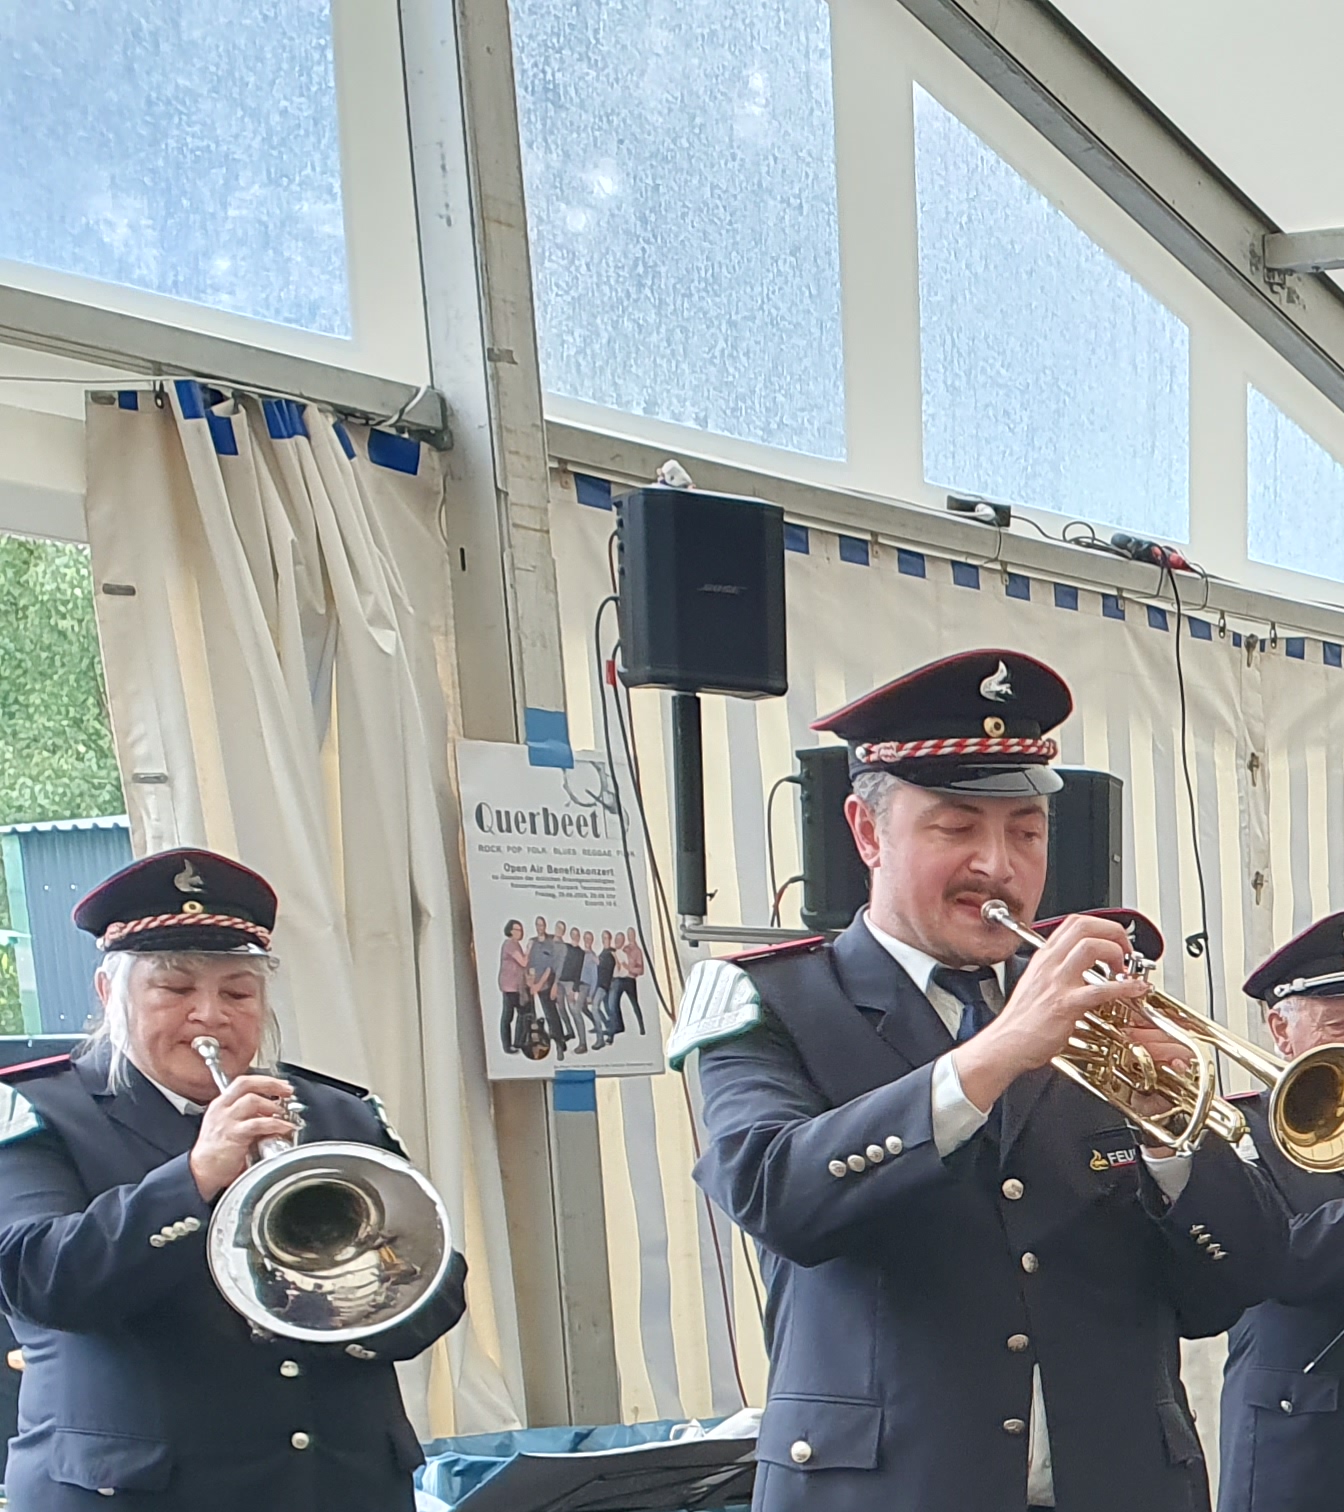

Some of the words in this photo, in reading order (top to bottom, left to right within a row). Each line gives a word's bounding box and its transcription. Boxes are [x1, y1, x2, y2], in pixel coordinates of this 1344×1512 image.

[475, 801, 601, 839] Querbeet
[478, 844, 502, 853] ROCK
[506, 845, 522, 854] POP
[527, 846, 547, 854] FOLK
[553, 847, 577, 856] BLUES
[582, 848, 612, 857] REGGAE
[503, 862, 527, 874] Open
[530, 864, 543, 874] Air
[546, 864, 615, 877] Benefizkonzert
